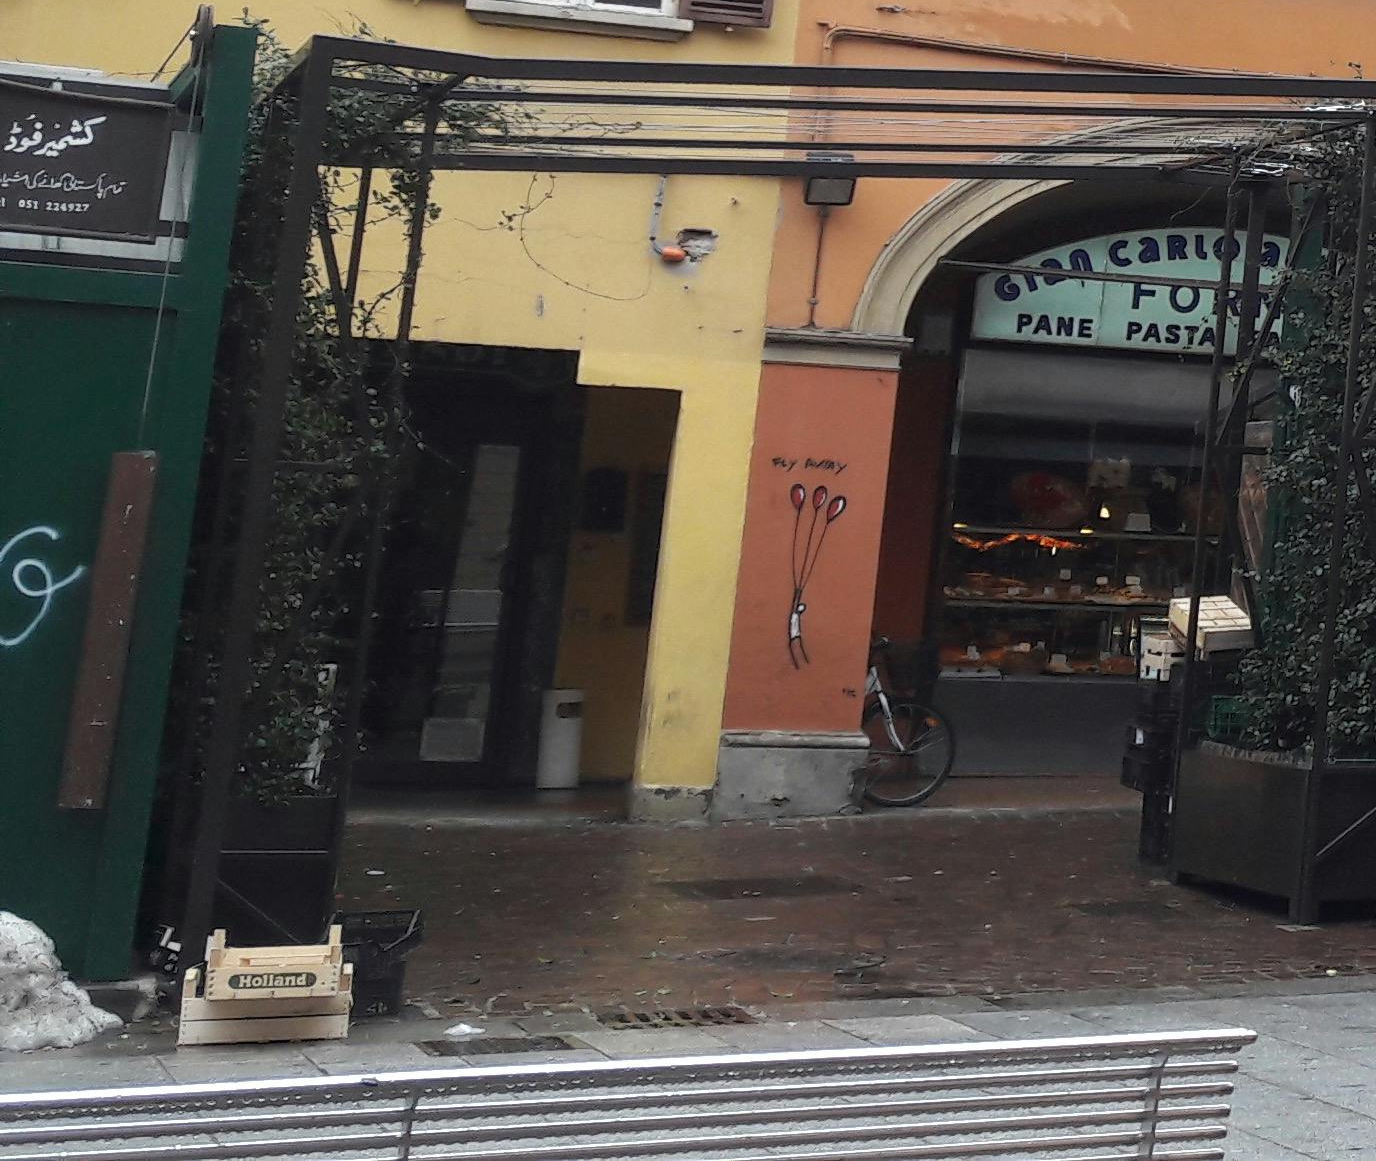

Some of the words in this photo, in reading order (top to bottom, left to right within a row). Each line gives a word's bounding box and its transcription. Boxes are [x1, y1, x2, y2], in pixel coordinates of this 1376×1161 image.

[1016, 313, 1094, 339] PANE
[1125, 320, 1217, 347] PASTA
[237, 972, 308, 988] Holland
